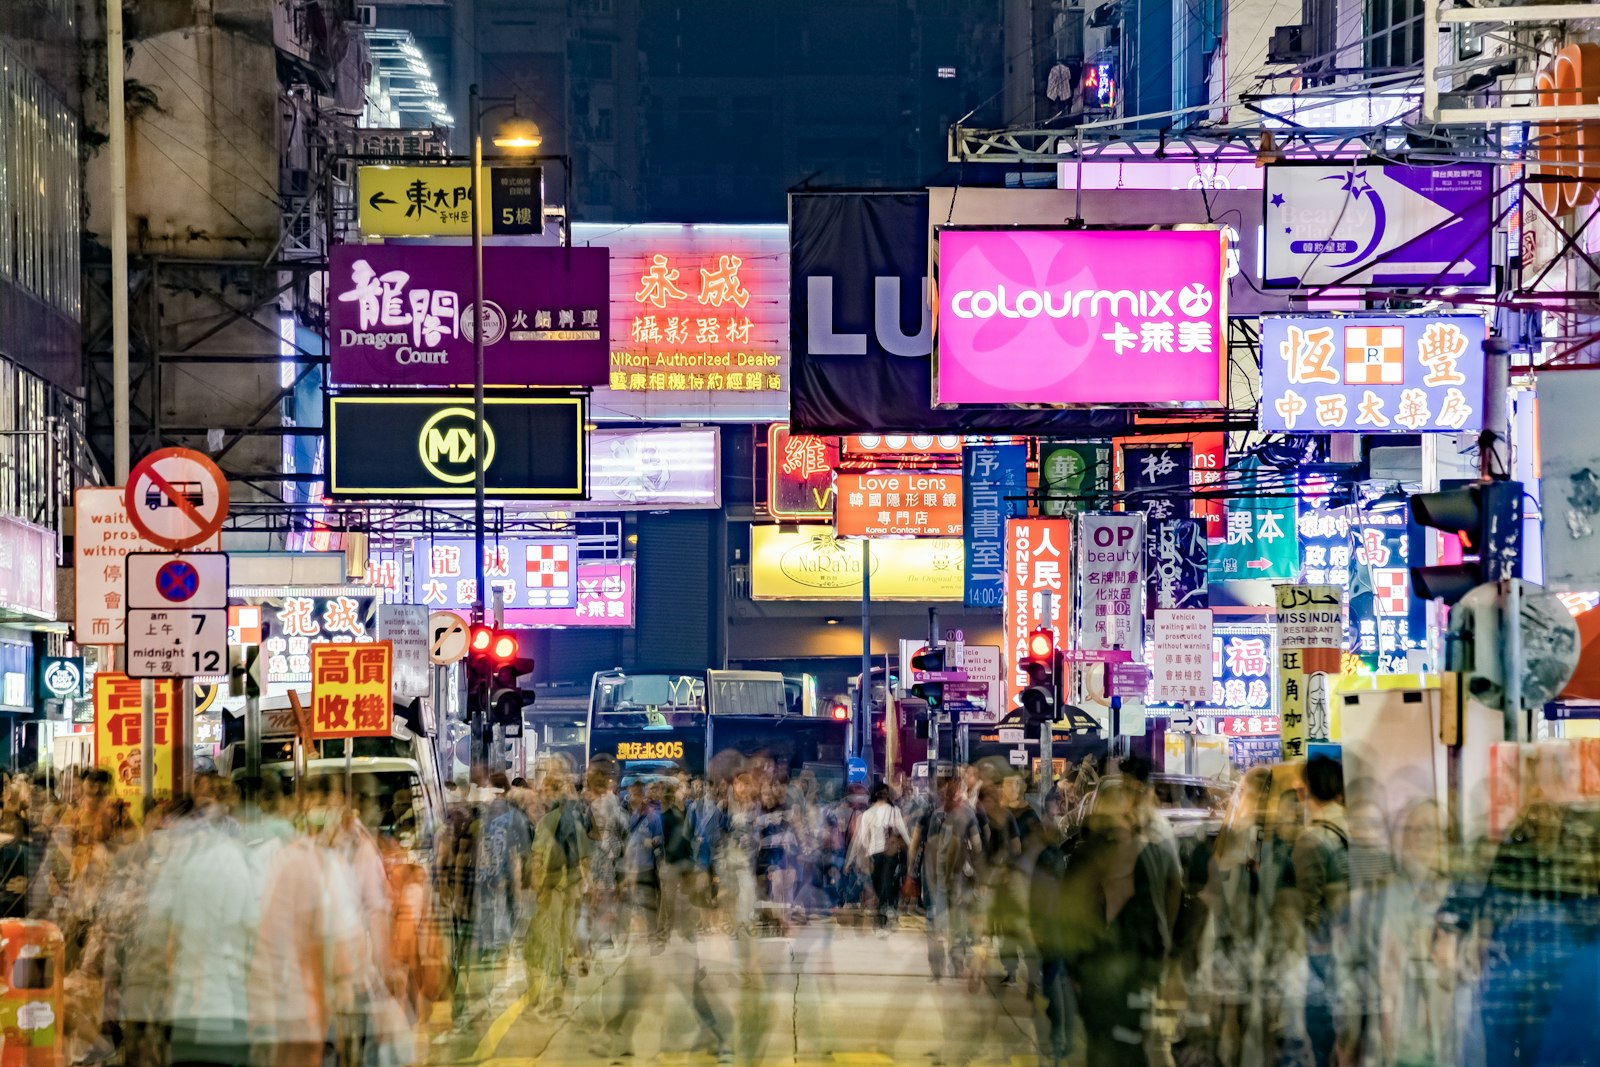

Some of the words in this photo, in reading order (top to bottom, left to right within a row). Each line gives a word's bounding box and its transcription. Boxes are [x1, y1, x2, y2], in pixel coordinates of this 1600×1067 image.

[635, 254, 750, 308] 永成
[511, 309, 599, 329] 火鍋料理
[632, 315, 755, 344] 攝影器材
[340, 329, 409, 350] Dragon
[1102, 321, 1213, 355] 卡萊美
[395, 346, 449, 365] Court
[610, 352, 650, 366] Nikon
[656, 352, 730, 366] Authorized
[737, 352, 782, 366] Dealer
[1275, 388, 1473, 430] 中西大藥房
[858, 475, 899, 491] Love
[908, 475, 947, 491] Lens
[849, 493, 957, 508] 韓國隱形眼鏡
[970, 448, 1001, 570] 序言書室
[877, 511, 928, 525] 專門店
[890, 526, 921, 534] Contact
[1093, 526, 1135, 548] OP
[1015, 526, 1030, 587] MONEY
[1087, 550, 1140, 563] beauty
[1088, 571, 1139, 585] 名牌開倉
[1095, 588, 1132, 601] 化妝品
[1281, 588, 1339, 609] حلال
[150, 612, 168, 620] am
[277, 597, 367, 638] 龍城
[1171, 612, 1195, 621] Vehicle
[1277, 613, 1306, 623] MISS
[1309, 612, 1341, 623] INDIA
[145, 623, 173, 636] 上午
[191, 614, 207, 635] 7
[1160, 623, 1184, 632] waiting
[1186, 623, 1198, 631] will
[1199, 623, 1207, 631] be
[1283, 626, 1334, 634] RESTAURANT
[1165, 633, 1202, 642] prosecuted
[133, 648, 185, 659] midnight
[1184, 643, 1210, 651] warning
[145, 660, 173, 673] 午夜
[192, 650, 221, 672] 12
[318, 649, 386, 684] 高價
[1165, 654, 1202, 665] 停車等候
[1166, 670, 1202, 681] 會被檢控
[1160, 685, 1206, 697] 而不予警告
[318, 693, 386, 730] 收機
[656, 741, 684, 759] 905
